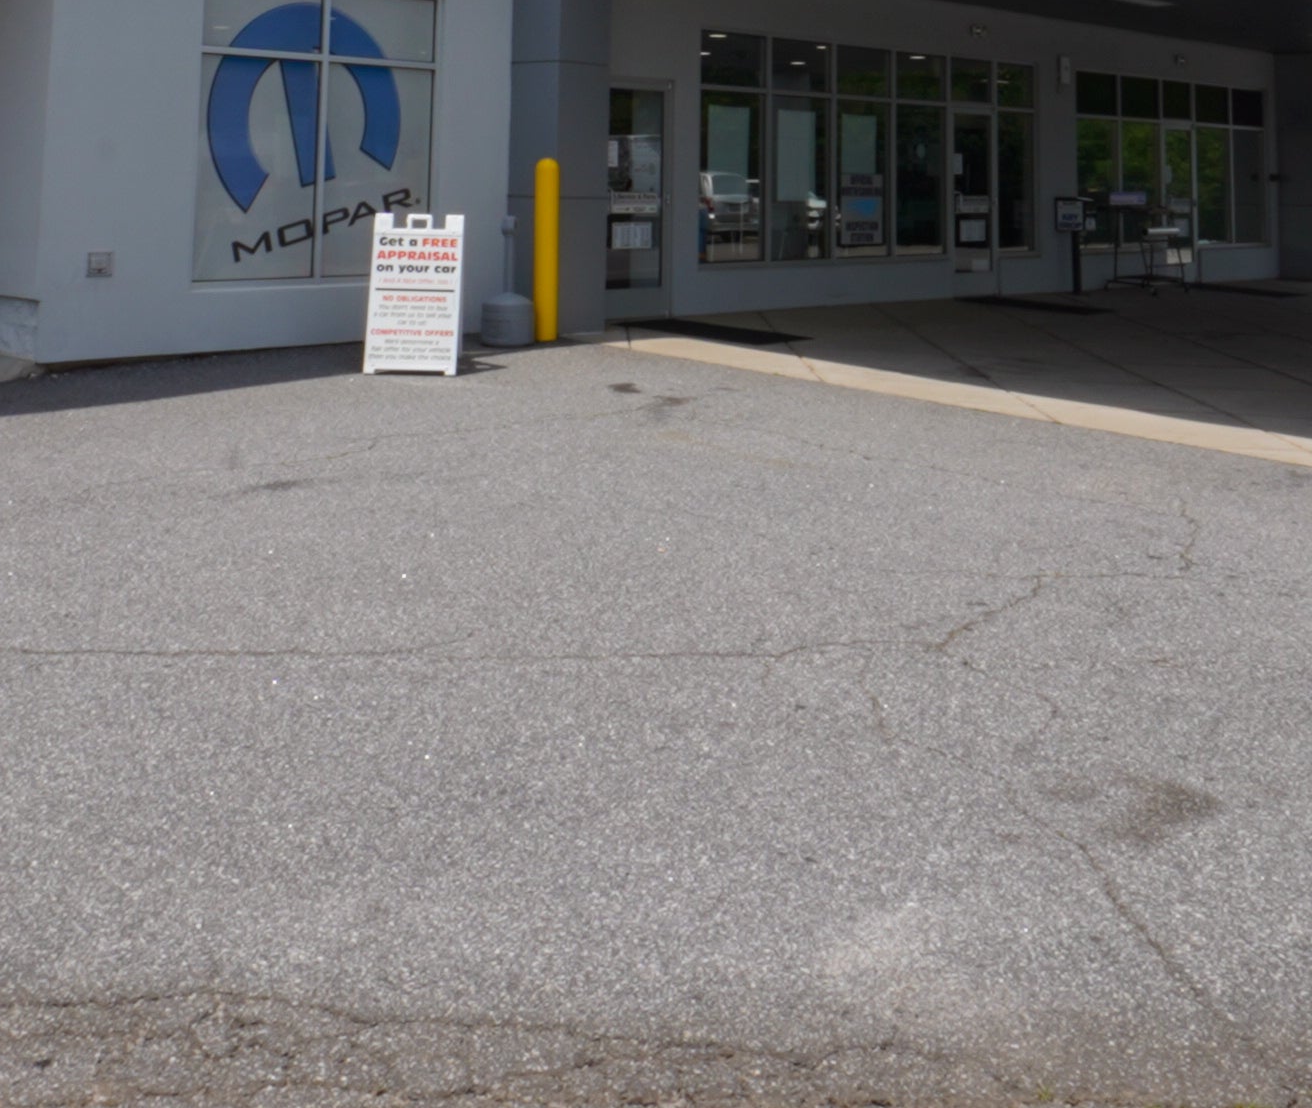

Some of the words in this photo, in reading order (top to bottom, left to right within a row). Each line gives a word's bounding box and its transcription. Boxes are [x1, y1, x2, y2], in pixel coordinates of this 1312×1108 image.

[231, 188, 413, 263] MOPAR
[379, 236, 404, 246] Get
[422, 238, 458, 247] FREE
[377, 250, 458, 261] APPRAISAL
[376, 264, 394, 272] on
[399, 265, 430, 274] your
[434, 265, 457, 273] car
[396, 295, 447, 303] OBLIGATIONS
[370, 328, 422, 336] COMPETITIVE
[425, 329, 454, 337] OFFERS
